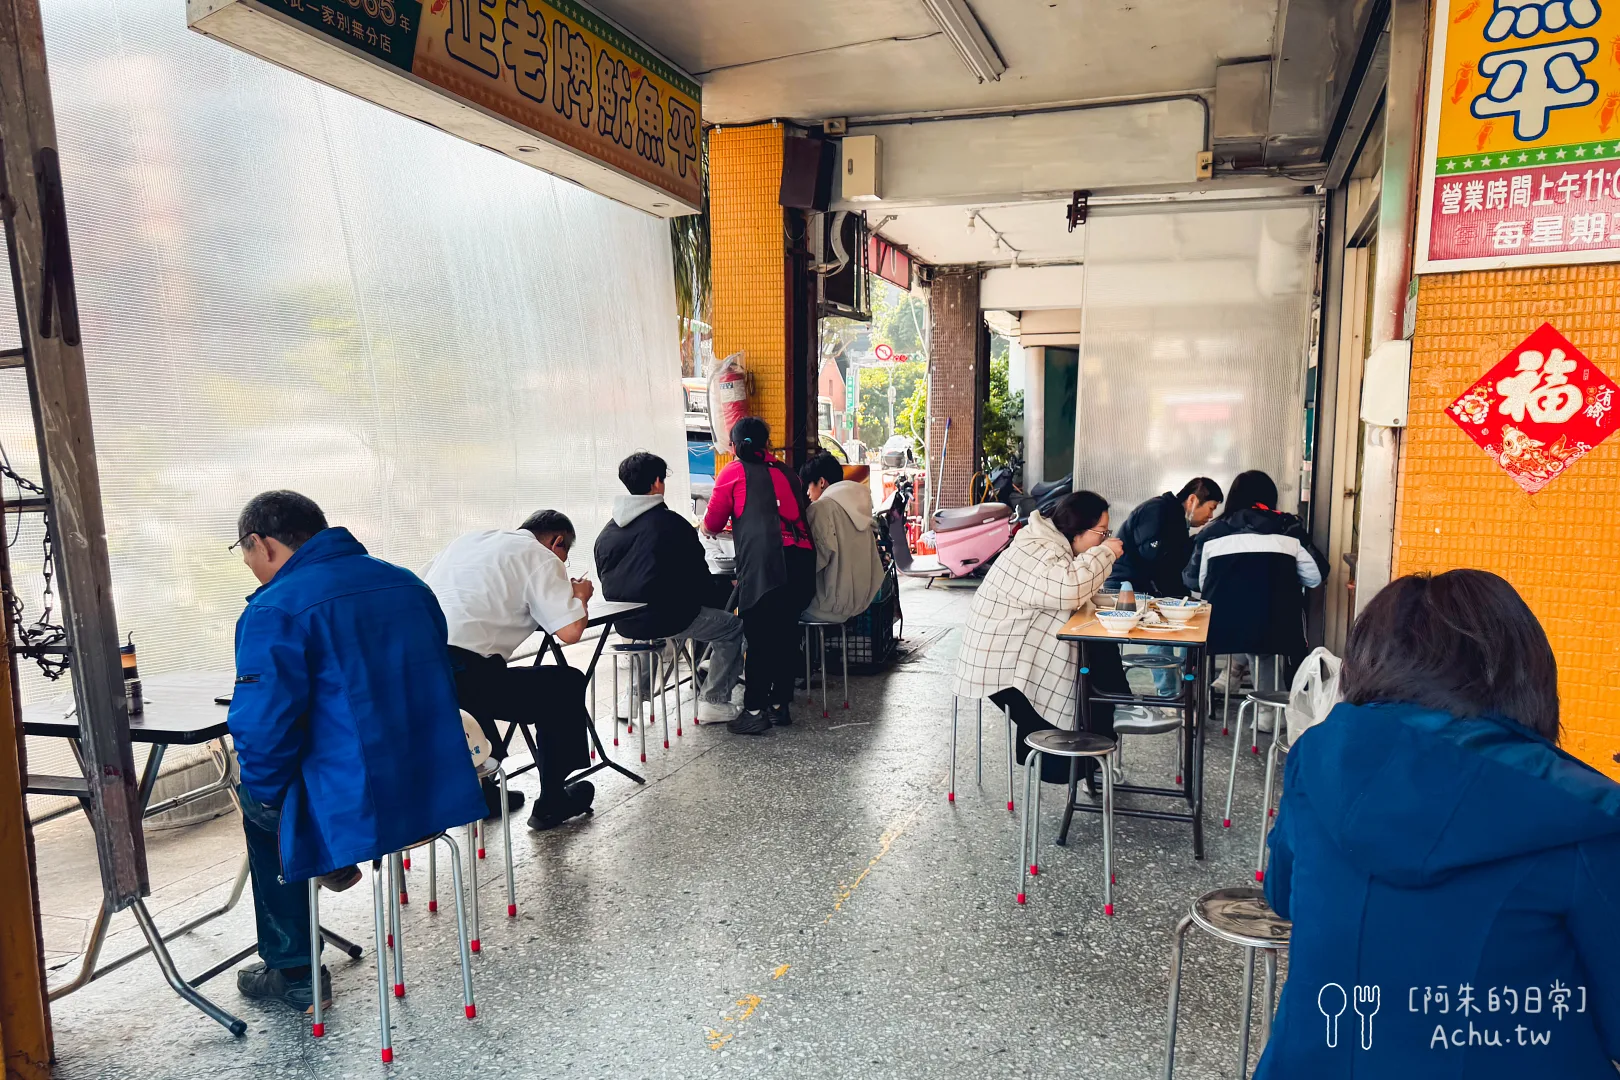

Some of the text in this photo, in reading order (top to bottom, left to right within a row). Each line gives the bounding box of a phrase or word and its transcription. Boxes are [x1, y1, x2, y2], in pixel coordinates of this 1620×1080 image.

[284, 0, 392, 53] 此一家別無分店
[445, 0, 696, 178] 正老牌魷魚平
[1496, 348, 1584, 424] 福
